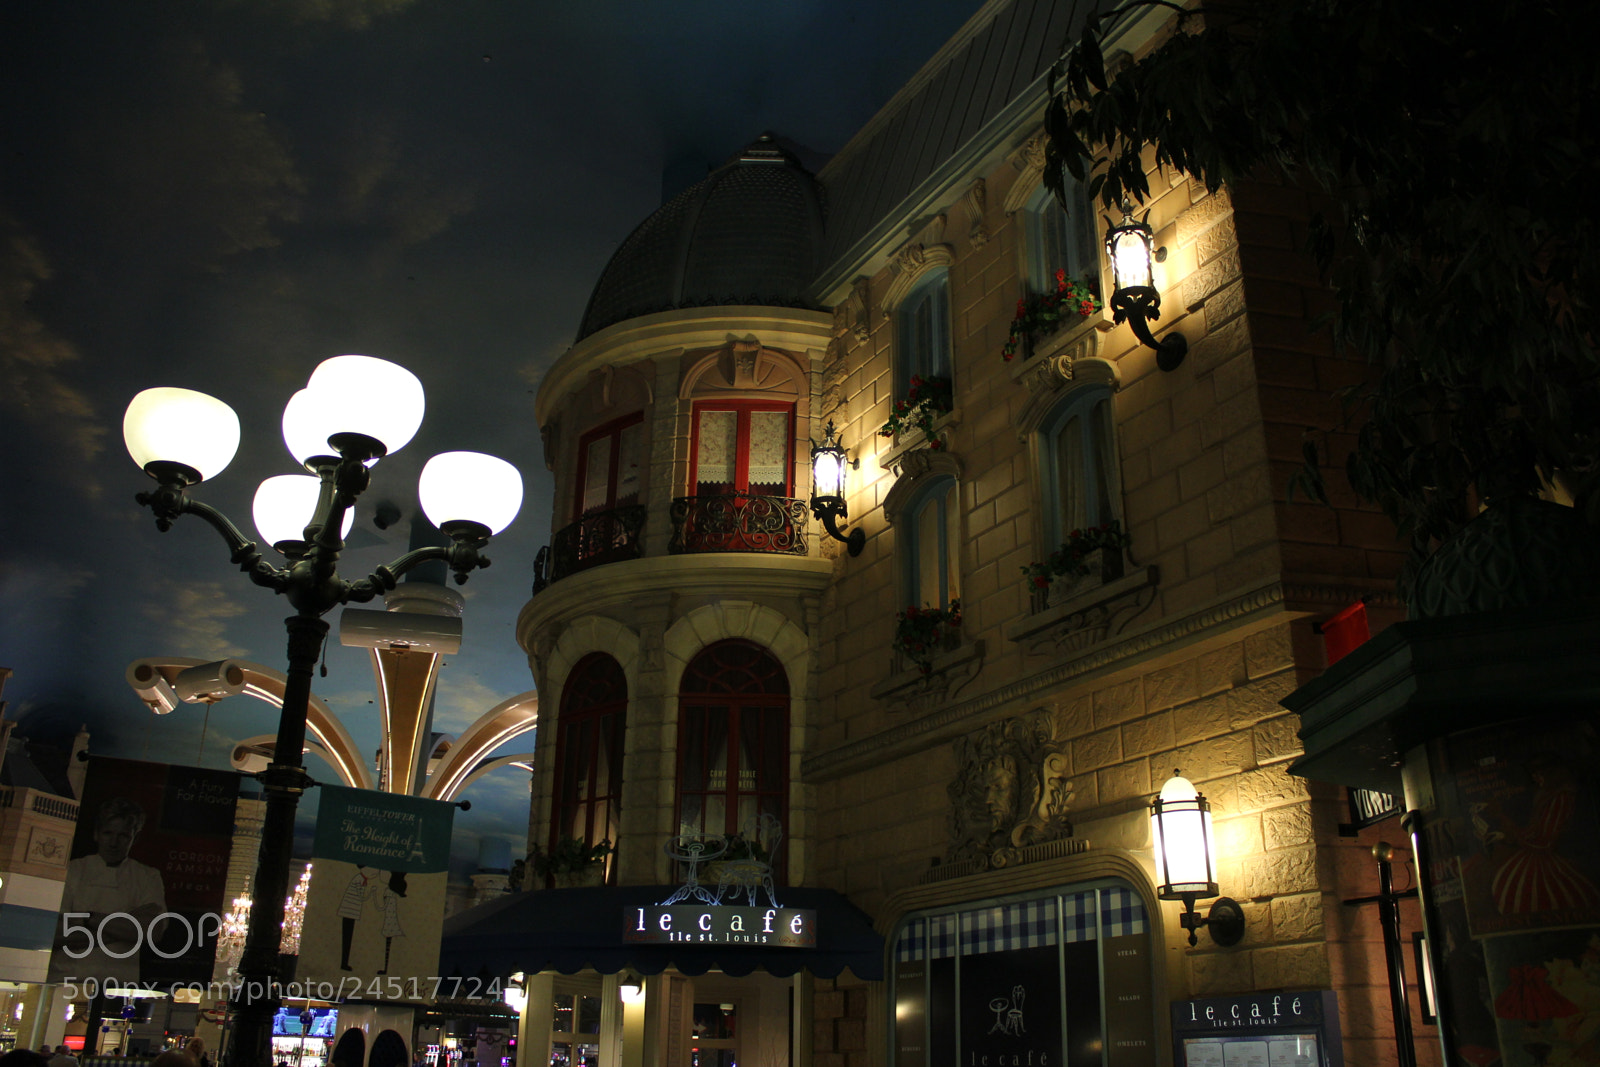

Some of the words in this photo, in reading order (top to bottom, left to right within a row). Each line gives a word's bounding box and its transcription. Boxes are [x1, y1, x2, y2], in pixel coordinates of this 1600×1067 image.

[177, 788, 194, 801] For
[198, 792, 233, 805] Flavor
[341, 820, 361, 834] The
[361, 825, 400, 848] Height
[401, 835, 414, 850] of
[344, 835, 405, 857] Romance
[168, 850, 225, 864] GORDON
[166, 862, 223, 875] RAMSAY
[636, 908, 672, 932] le
[698, 909, 803, 935] café
[726, 933, 768, 943] louis
[1190, 1002, 1214, 1021] le
[1231, 995, 1302, 1019] café
[1249, 1017, 1278, 1025] louis
[972, 1050, 988, 1066] le
